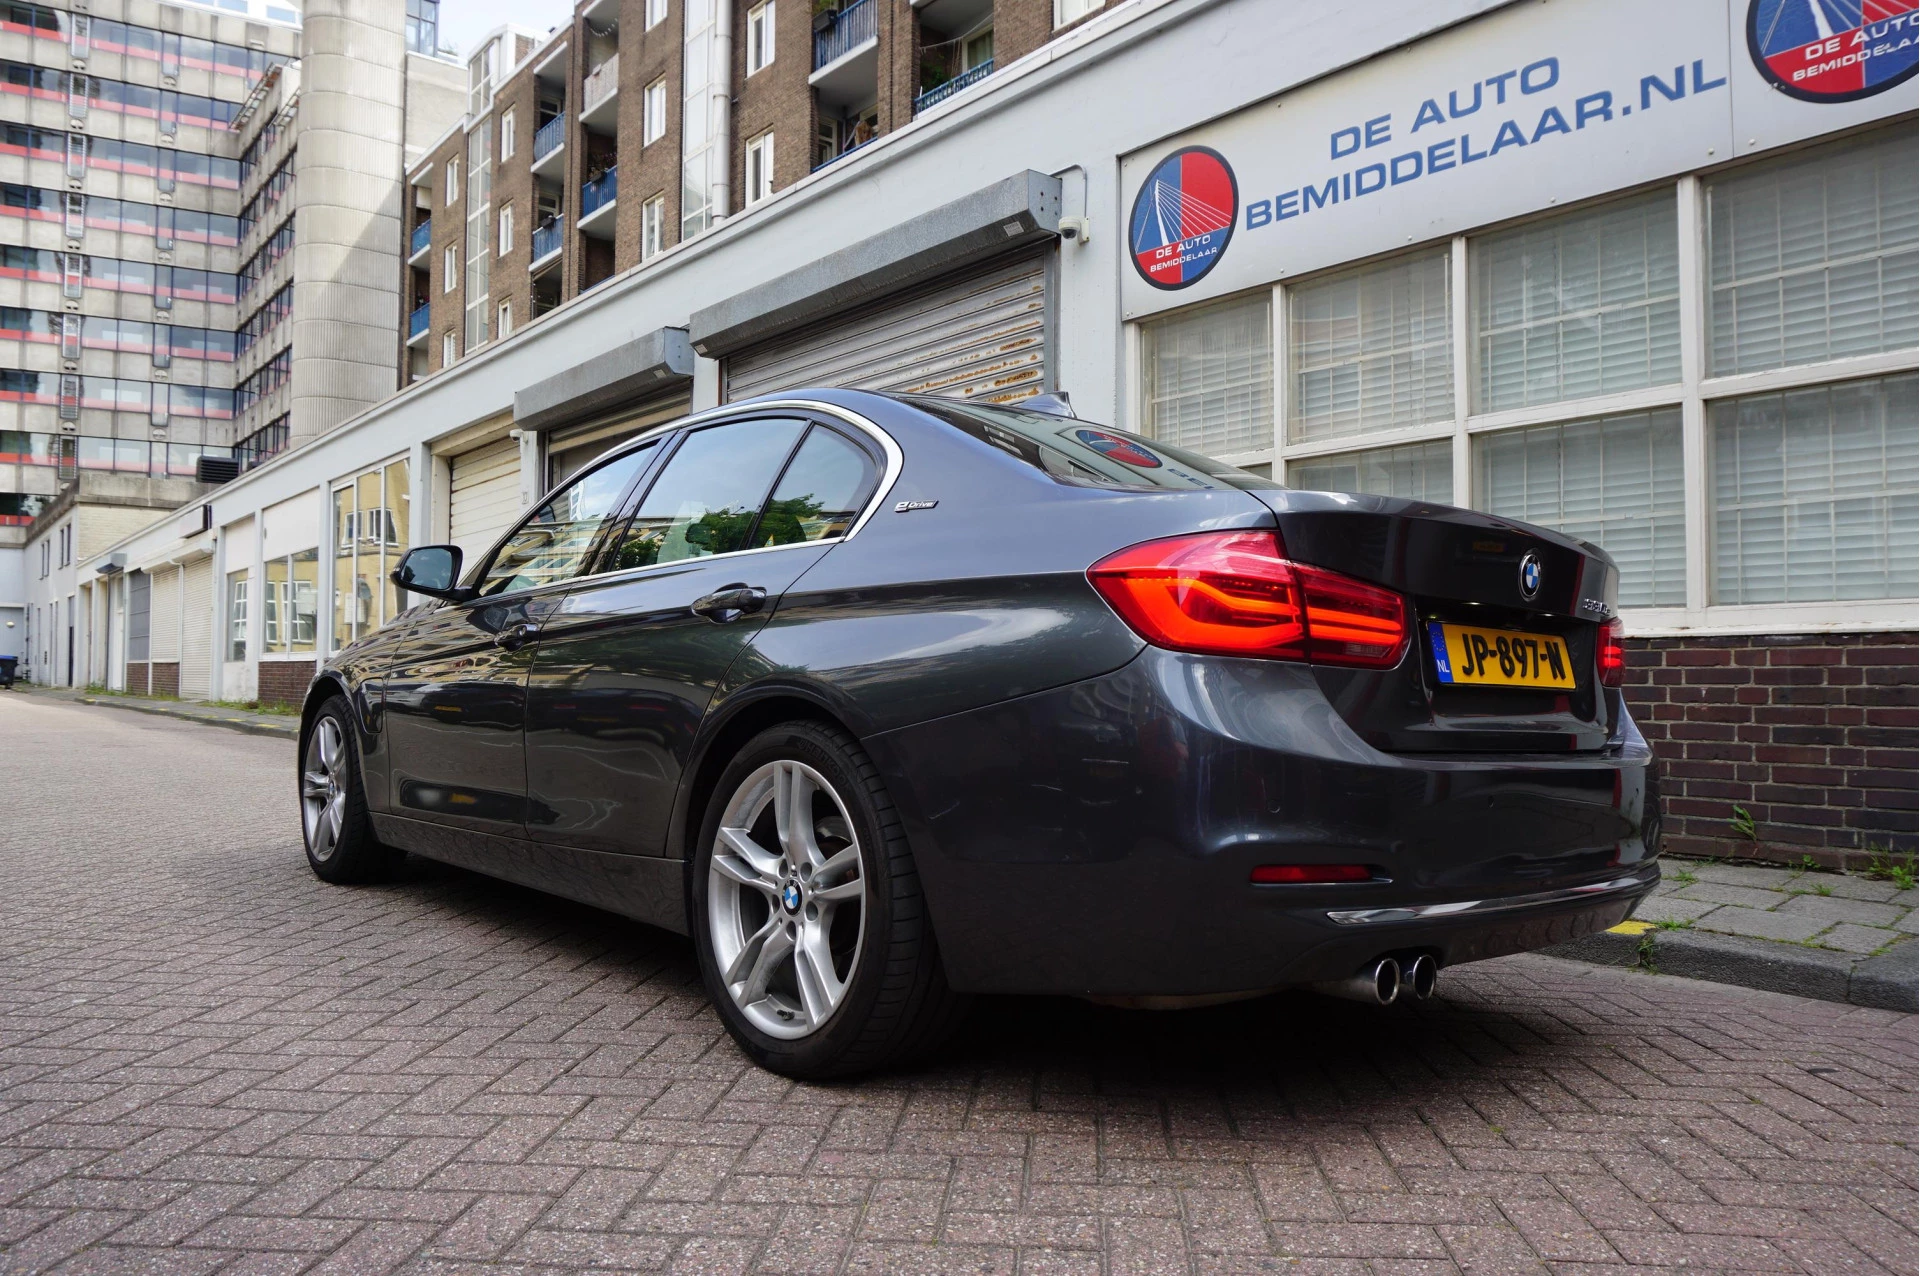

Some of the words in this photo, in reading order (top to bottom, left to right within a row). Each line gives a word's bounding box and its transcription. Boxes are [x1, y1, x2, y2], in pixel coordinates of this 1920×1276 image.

[1805, 37, 1841, 60] DE
[1330, 113, 1392, 161] DE
[1410, 56, 1560, 134] AUTO
[1246, 58, 1727, 231] BEMIDDELAAR.NL
[1150, 247, 1217, 272] BEMIDDELAAR
[1156, 247, 1172, 259] DE
[1176, 235, 1211, 252] AUTO
[1437, 659, 1451, 673] NL
[1461, 633, 1567, 681] JP-897-N
